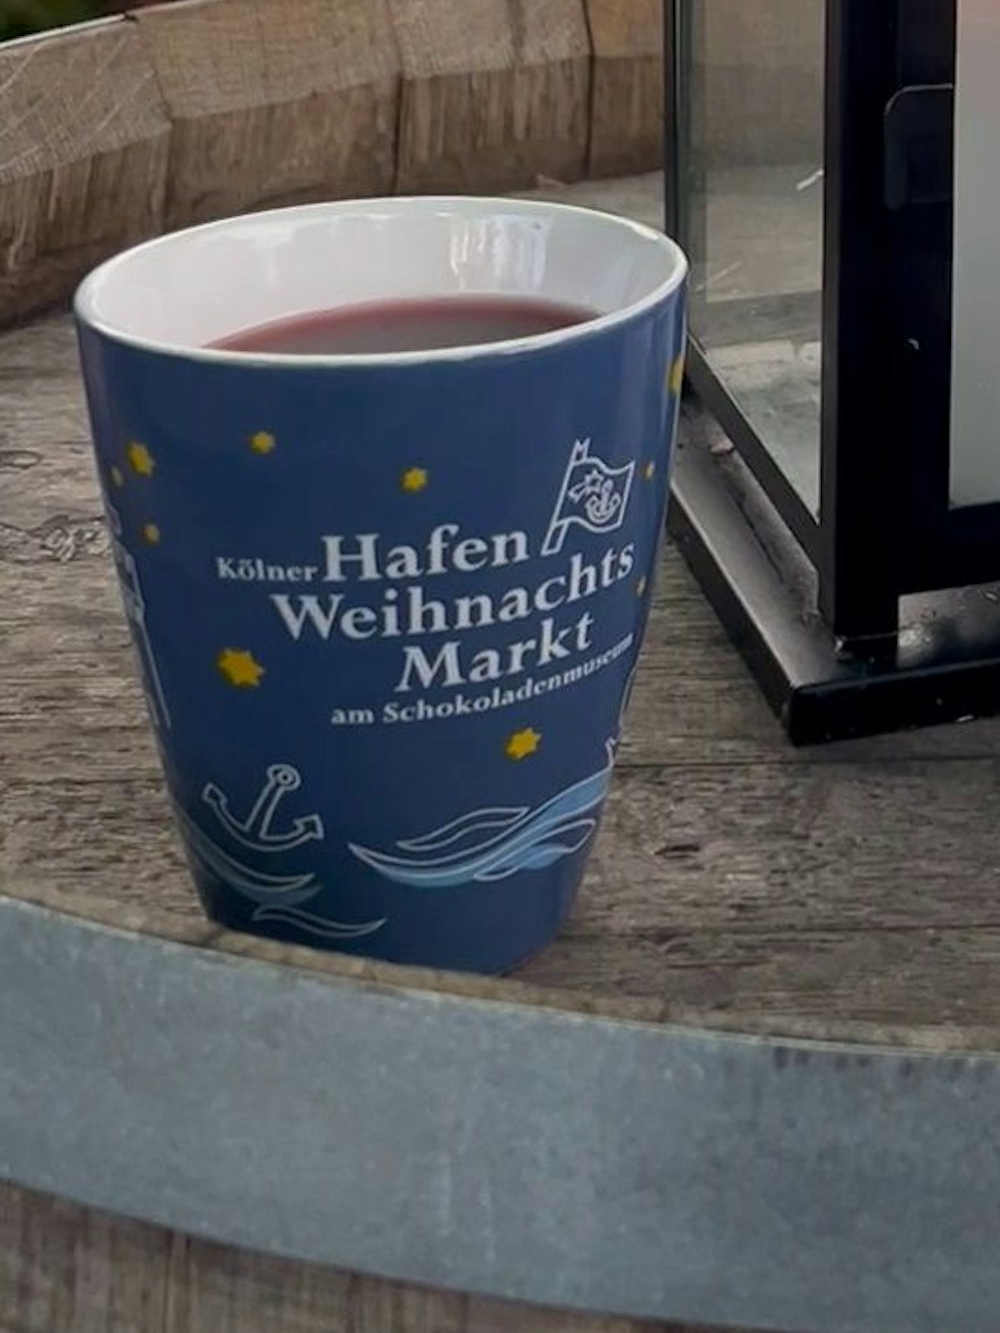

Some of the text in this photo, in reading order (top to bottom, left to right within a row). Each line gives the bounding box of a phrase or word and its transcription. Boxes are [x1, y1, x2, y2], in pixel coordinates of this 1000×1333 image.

[217, 523, 530, 583] Kölner Hafen
[270, 542, 636, 640] Weihnachts
[394, 611, 594, 693] Markt
[331, 708, 374, 725] am
